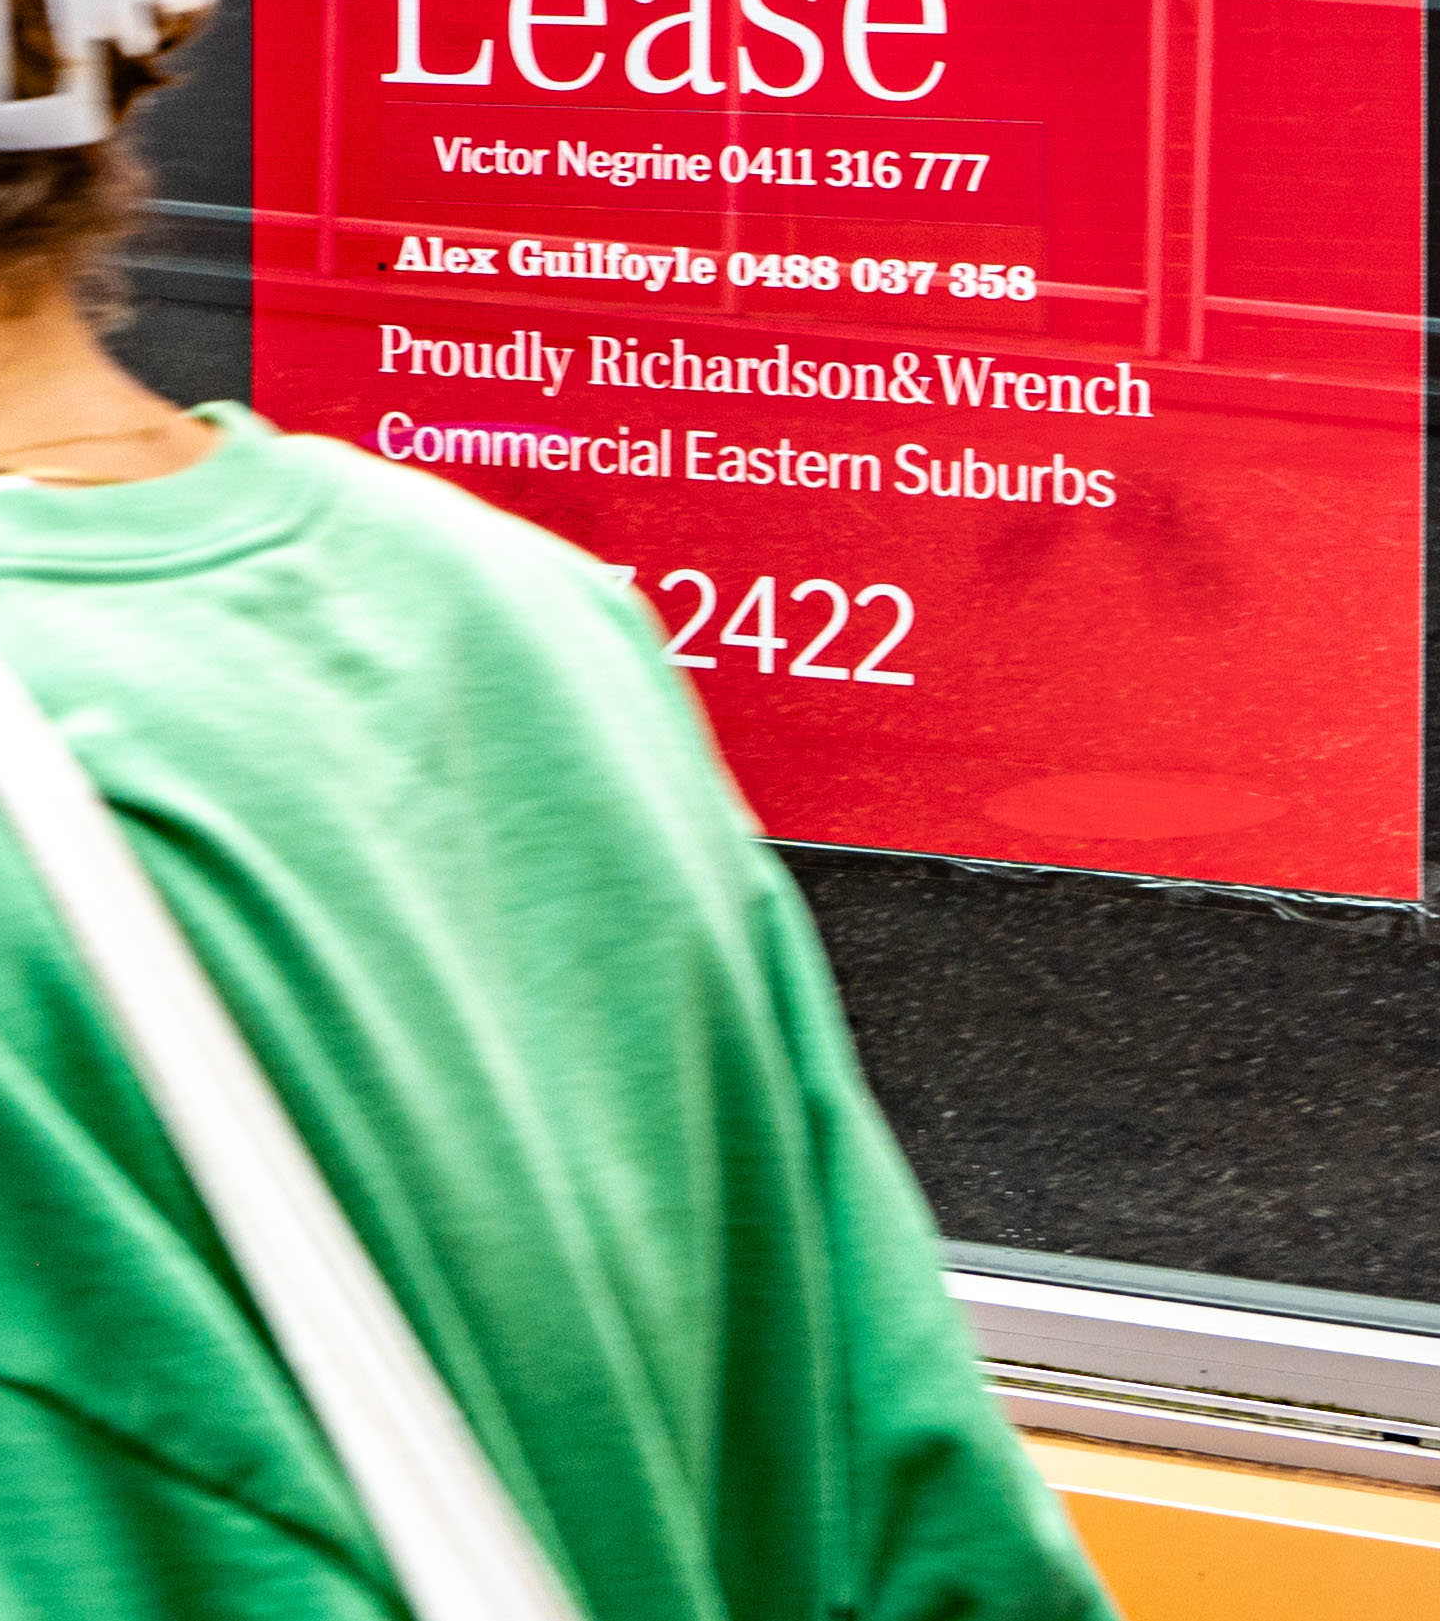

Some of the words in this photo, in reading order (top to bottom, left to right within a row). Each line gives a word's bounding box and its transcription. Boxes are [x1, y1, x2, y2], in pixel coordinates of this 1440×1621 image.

[433, 135, 548, 176] Victor
[558, 139, 712, 188] Negrine
[720, 145, 815, 186] 0411
[825, 149, 902, 189] 316
[911, 151, 991, 192] 777
[394, 235, 499, 278] Alex
[508, 239, 717, 290] Guilfoyle
[727, 250, 842, 292] 0488
[852, 257, 938, 296] 037
[948, 264, 1038, 303] 358
[378, 324, 574, 396] Proudly
[587, 334, 1154, 419] Richardson&Wrench
[376, 410, 672, 480] Commercial
[686, 430, 881, 493] Eastern
[894, 442, 1117, 509] Suburbs
[659, 568, 916, 686] 2422
